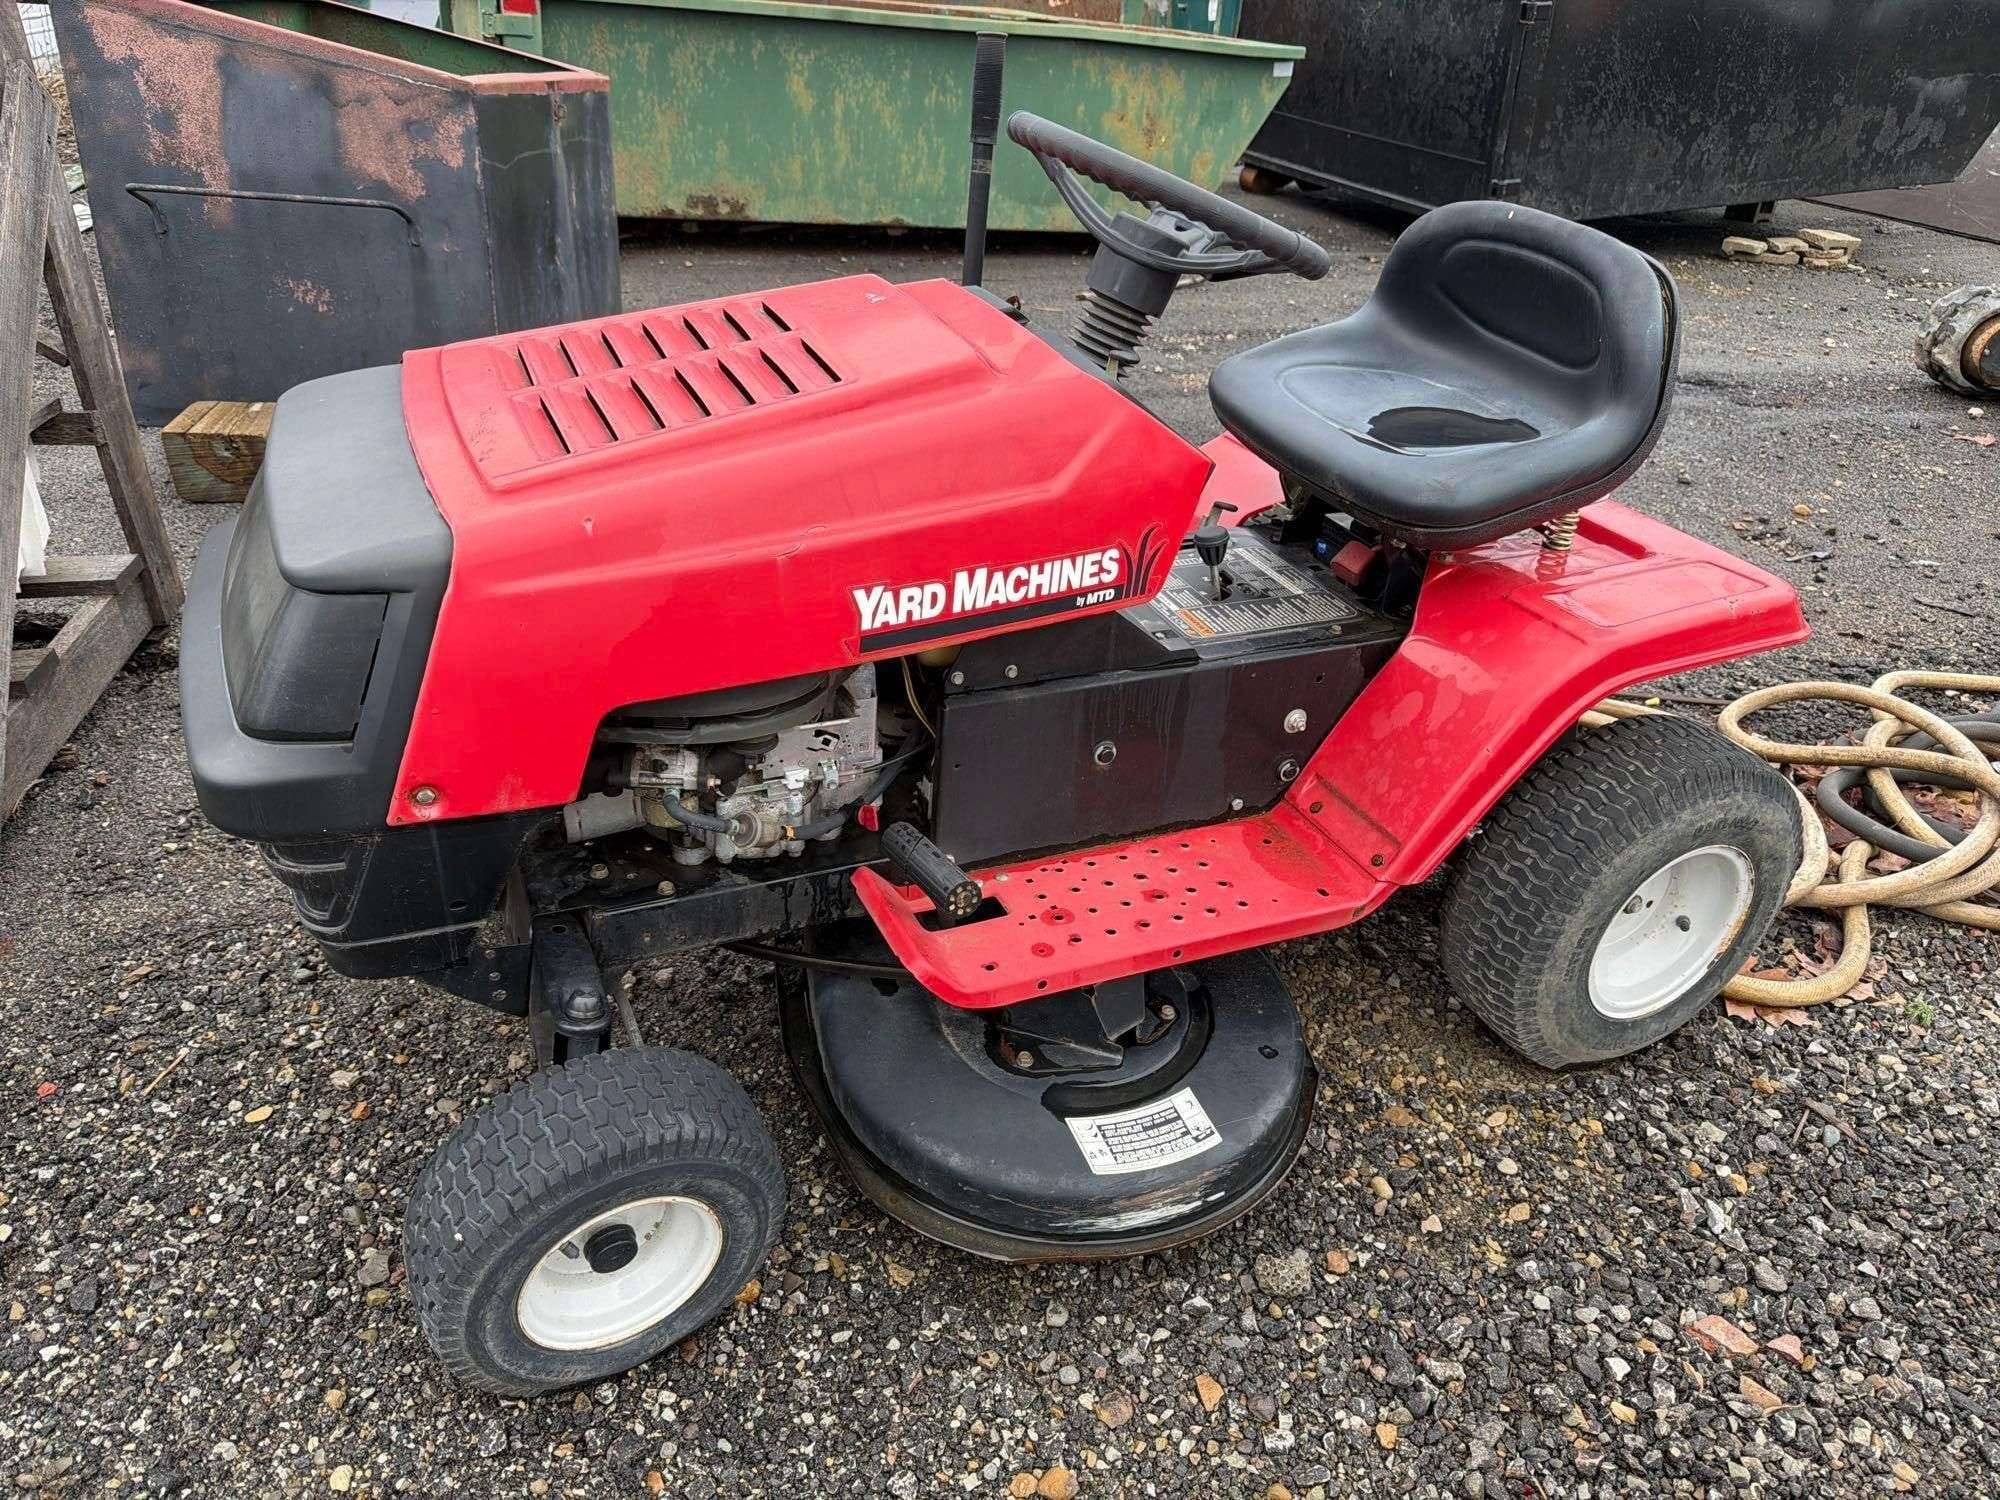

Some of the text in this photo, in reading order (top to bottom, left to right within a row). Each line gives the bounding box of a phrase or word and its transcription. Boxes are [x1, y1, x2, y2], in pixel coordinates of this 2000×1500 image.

[853, 582, 946, 631] YARD
[952, 548, 1120, 614] MACHINES
[1076, 588, 1116, 608] by MTD
